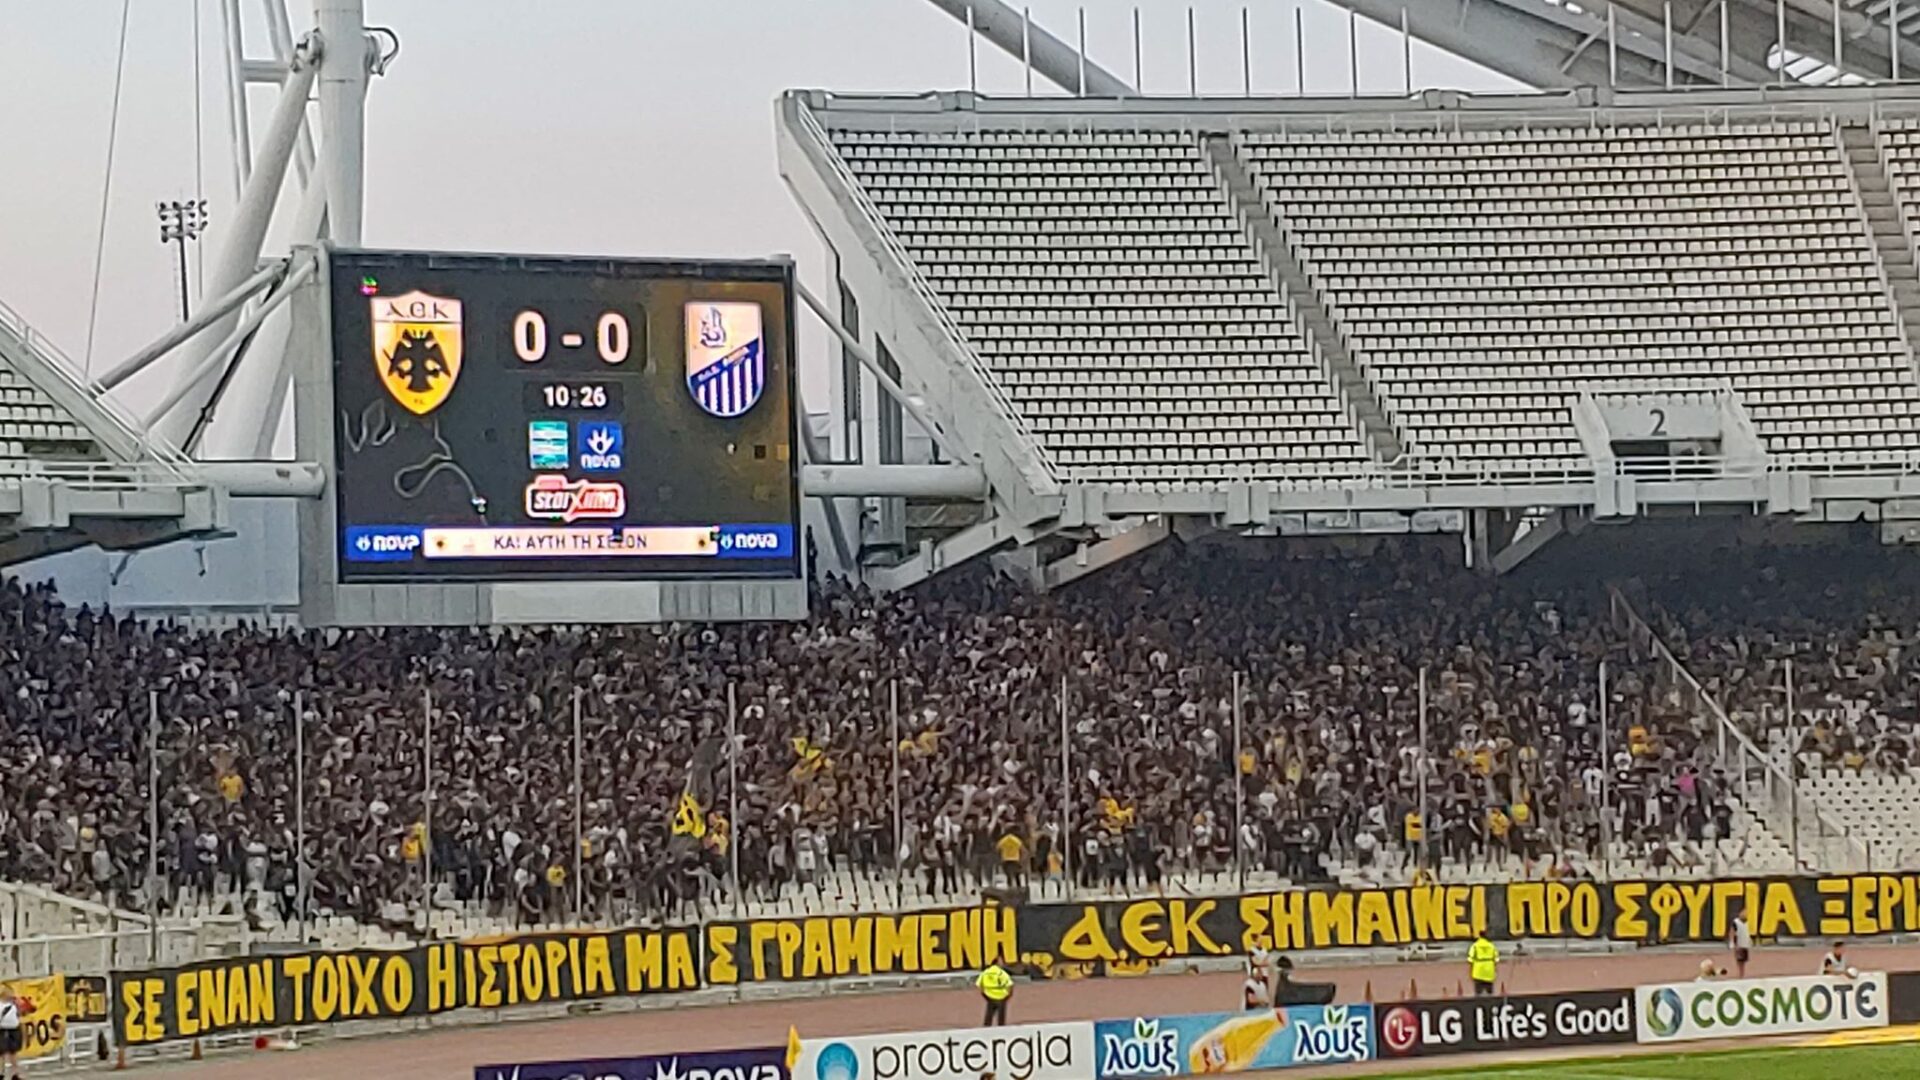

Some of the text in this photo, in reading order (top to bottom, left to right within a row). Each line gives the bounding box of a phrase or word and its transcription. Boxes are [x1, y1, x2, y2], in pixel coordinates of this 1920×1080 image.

[514, 310, 547, 363] 0
[597, 312, 629, 364] 0
[544, 386, 606, 407] 10:26
[1650, 409, 1667, 436] 2
[581, 454, 621, 469] nova
[526, 535, 565, 549] ΑΥΤΗ
[571, 535, 591, 548] ΤΗ
[597, 534, 647, 549] ΣΕΟΝ
[735, 533, 778, 549] nova
[123, 978, 164, 1041] ΣΕ
[177, 960, 274, 1035] ΕΝΑΝ
[284, 956, 412, 1021] ΤΟΙΧΟ
[1241, 886, 1488, 952] ΣΗΜΑΙΝΕΙ
[1817, 877, 1920, 934] ΞΕΡΙ
[1422, 997, 1630, 1044] LG Life's Good
[1691, 982, 1878, 1028] COSMOTE
[873, 1031, 1072, 1080] protergia
